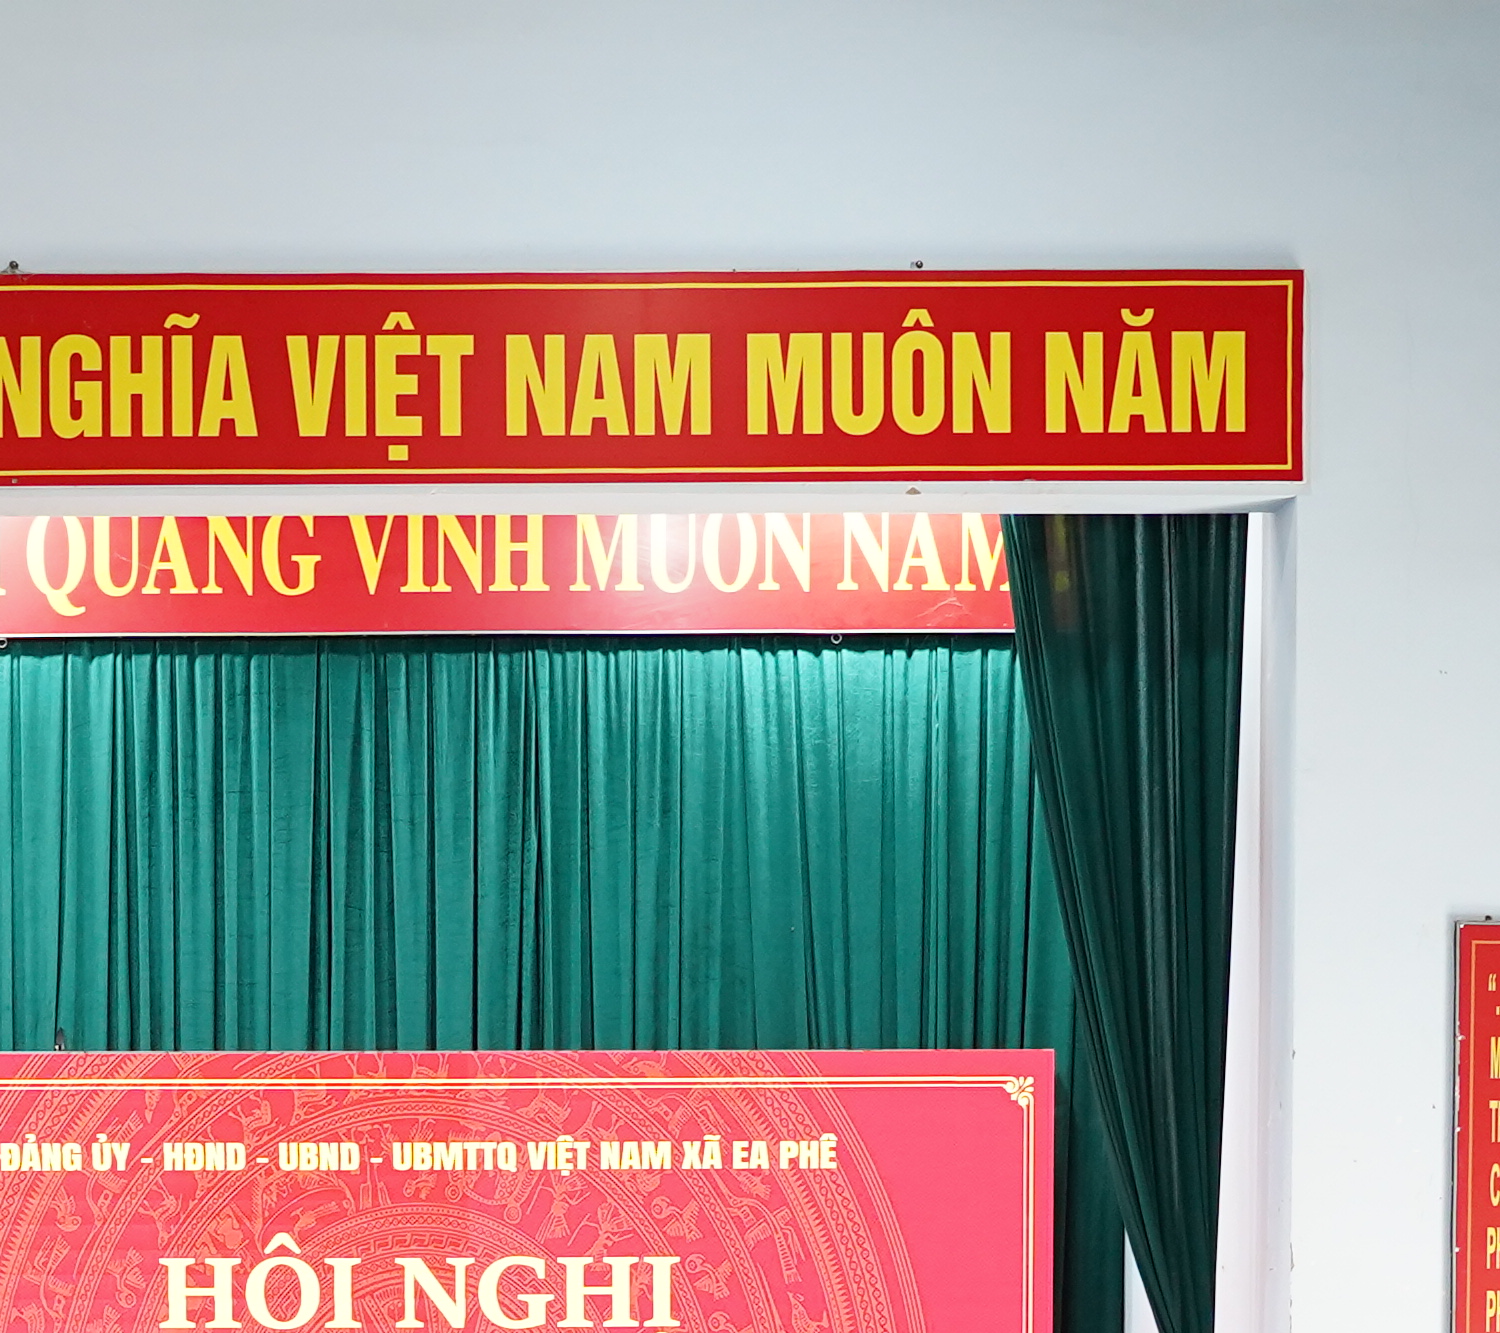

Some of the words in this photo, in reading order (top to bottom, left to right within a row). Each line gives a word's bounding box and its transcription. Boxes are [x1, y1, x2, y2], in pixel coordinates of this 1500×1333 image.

[288, 312, 476, 461] VIỆT
[506, 334, 714, 436] NAM
[747, 310, 1013, 435] MUÔN
[1044, 308, 1248, 434] NĂM
[26, 516, 321, 616] QUANG
[348, 514, 550, 595] VINH
[0, 1134, 83, 1171] ĐẢNG
[92, 1134, 130, 1171] ỦY
[164, 1142, 246, 1171] HĐND
[279, 1142, 360, 1171] UBND
[392, 1142, 517, 1172] UBMTTQ
[526, 1135, 589, 1176] VIỆT
[600, 1141, 671, 1170] NAM
[682, 1135, 725, 1169] XÃ
[732, 1140, 770, 1169] EA
[779, 1133, 838, 1169] PHÊ
